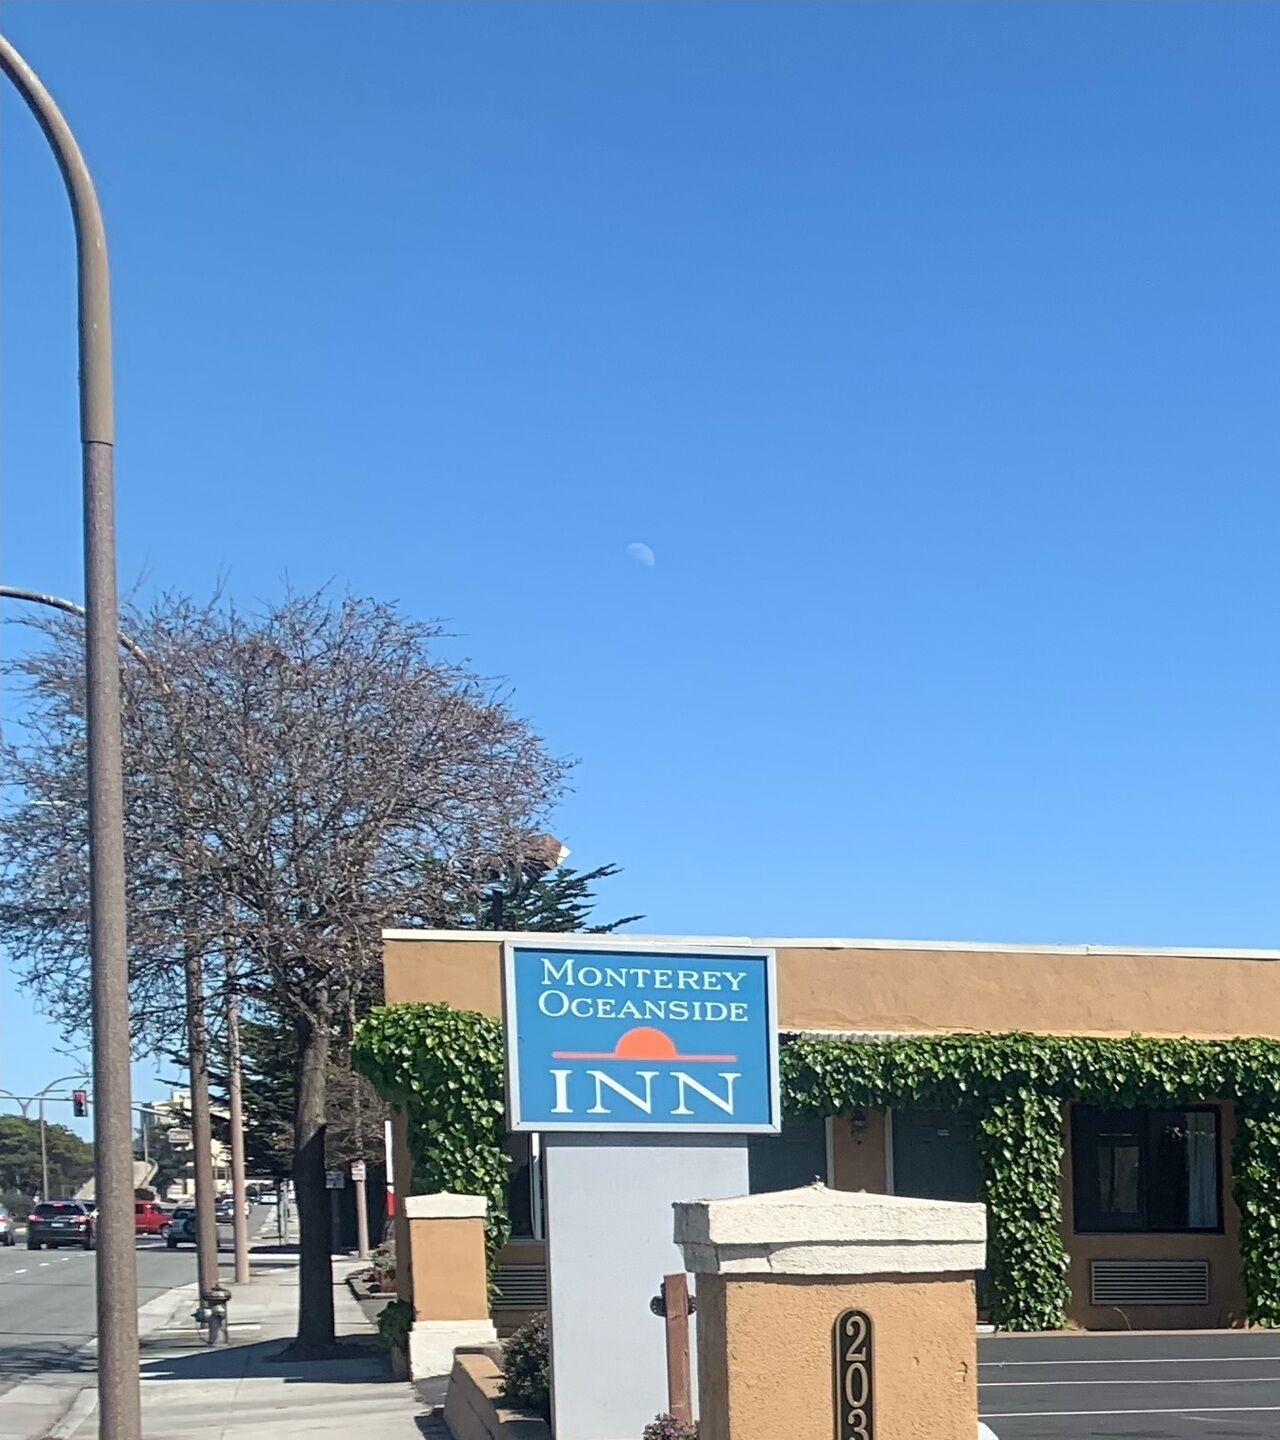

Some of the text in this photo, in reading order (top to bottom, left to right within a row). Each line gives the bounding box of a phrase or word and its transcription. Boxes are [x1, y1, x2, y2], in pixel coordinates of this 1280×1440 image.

[540, 958, 747, 991] MONTEREY
[538, 990, 748, 1022] OCEANSIDE
[549, 1069, 742, 1116] INN
